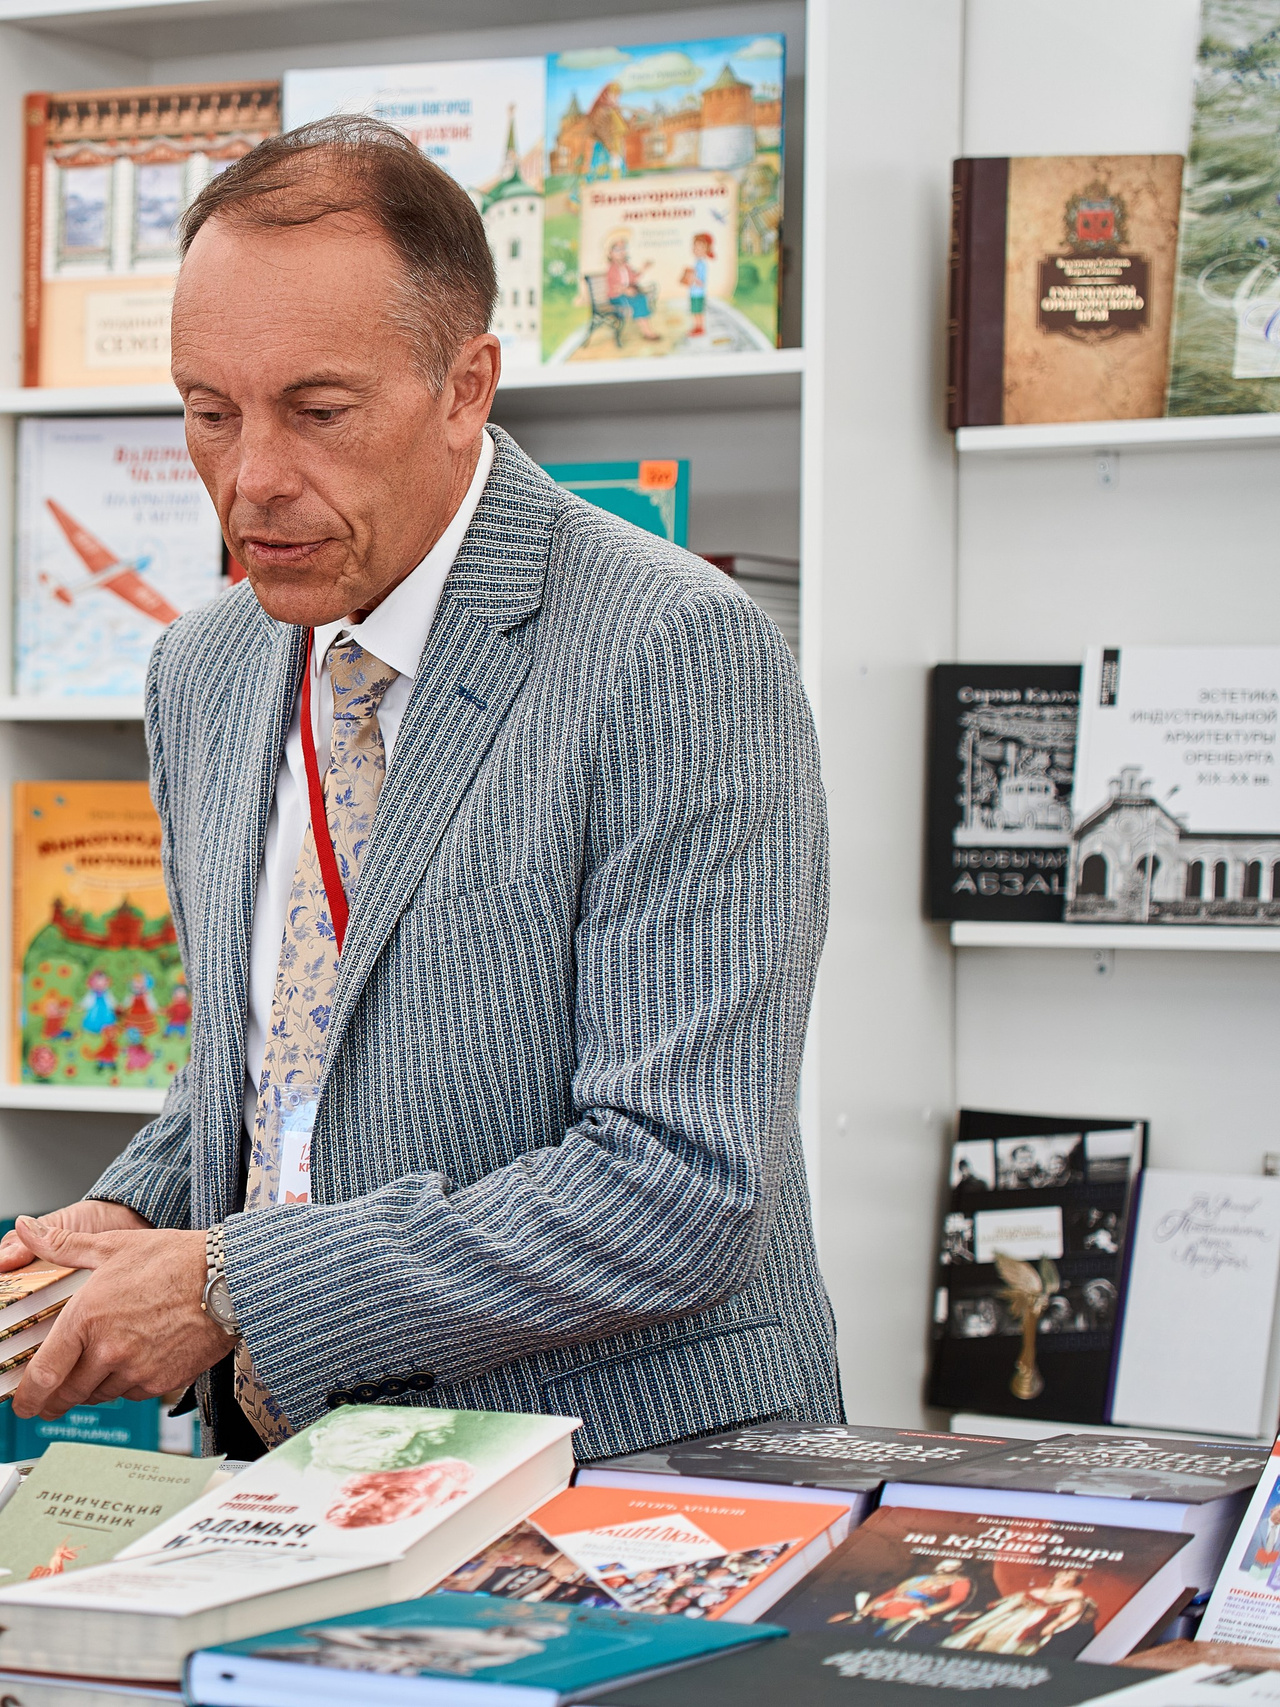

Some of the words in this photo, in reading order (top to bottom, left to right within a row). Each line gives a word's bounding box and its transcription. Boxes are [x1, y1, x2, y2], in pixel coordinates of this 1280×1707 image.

[957, 686, 1021, 707] Сергей
[1199, 688, 1279, 703] ЭСТЕТИКА
[1130, 707, 1278, 724] ИНДУСТРИАЛЬНОЙ
[1164, 729, 1276, 745] АРХИТЕКТУРЫ
[1183, 750, 1275, 766] ОРЕНБУРГА
[115, 1461, 160, 1473] КОНСТ.
[128, 1472, 191, 1485] СИМОНОВ
[36, 1490, 164, 1516] ЛИРИЧЕСКИЙ
[628, 1500, 677, 1511] ИГОРЬ
[681, 1505, 747, 1516] ХРАМОВ
[44, 1506, 136, 1528] ДНЕВНИК
[977, 1516, 1039, 1529] Владимир
[1042, 1519, 1095, 1533] Фетисов
[187, 1517, 318, 1539] АДАМЫЧ
[979, 1526, 1065, 1545] Дуэль
[903, 1532, 937, 1545] на
[942, 1533, 1046, 1554] Крыше
[1049, 1547, 1124, 1563] мира
[1218, 1617, 1242, 1626] ОЛЬГА
[1213, 1631, 1247, 1641] АЛЕКСЕЙ
[1248, 1636, 1274, 1645] РЕПИН
